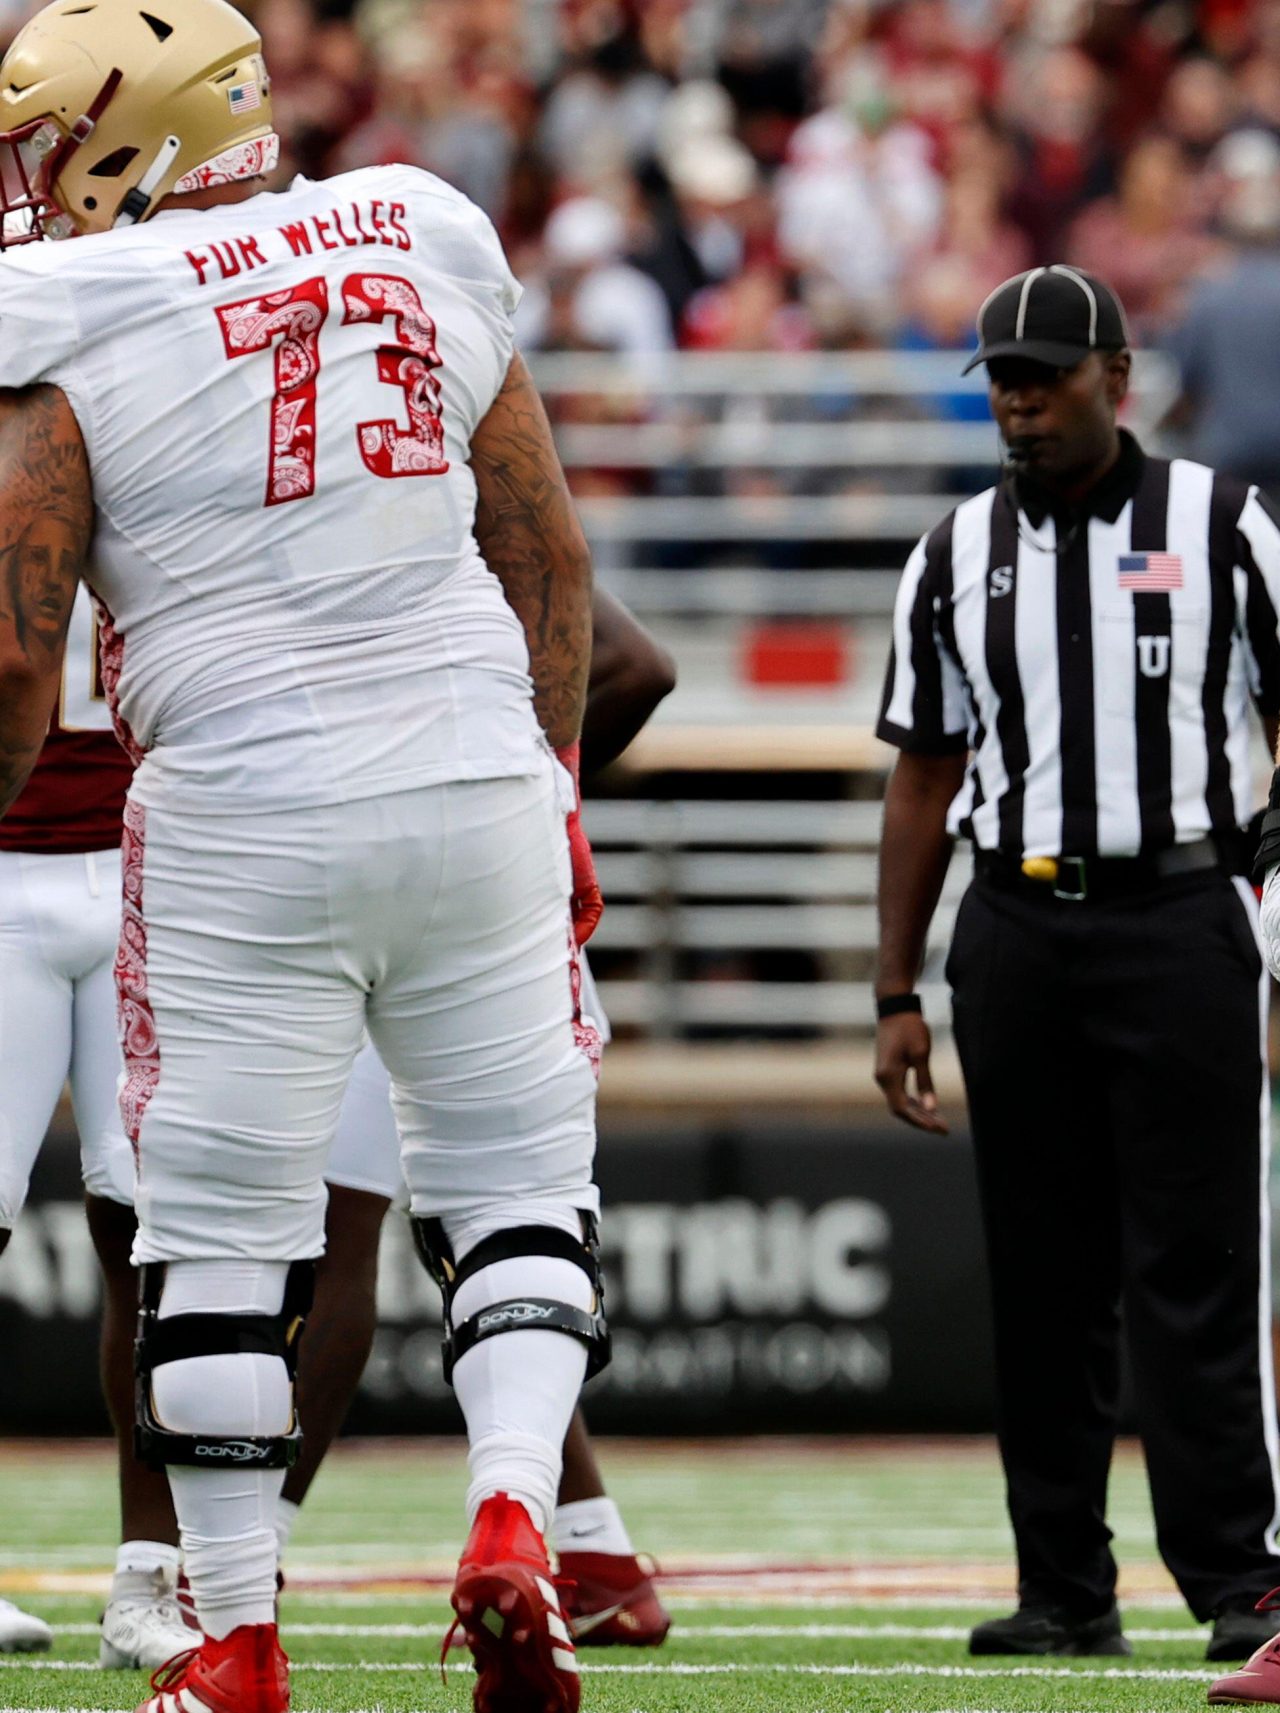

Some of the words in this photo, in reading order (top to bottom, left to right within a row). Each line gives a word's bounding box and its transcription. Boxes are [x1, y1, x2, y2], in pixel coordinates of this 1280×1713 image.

[277, 200, 412, 257] WELLES
[214, 273, 449, 508] 73
[989, 565, 1013, 598] S
[1137, 635, 1170, 678] U
[479, 1303, 558, 1328] DONJOY
[194, 1442, 273, 1460] DONJOY
